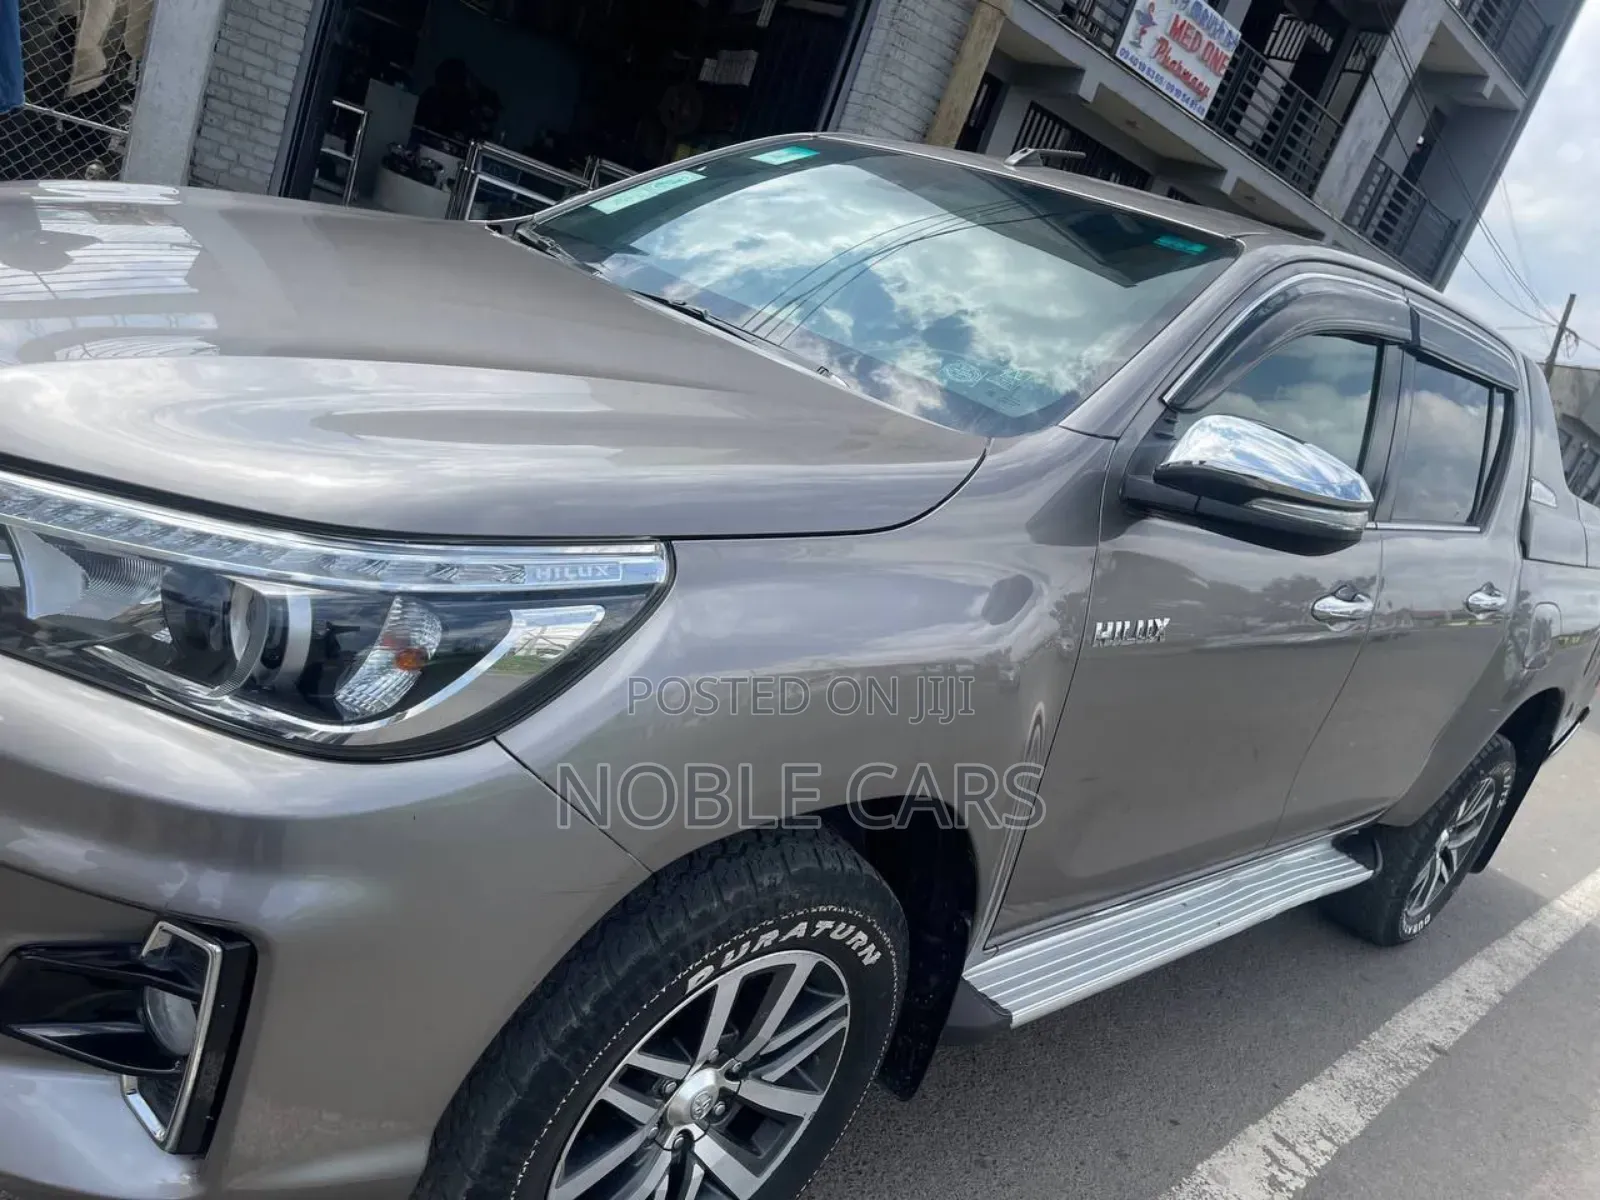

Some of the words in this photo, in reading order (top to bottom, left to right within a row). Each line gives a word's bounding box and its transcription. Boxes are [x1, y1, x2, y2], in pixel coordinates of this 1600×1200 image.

[1169, 13, 1203, 53] MED
[1202, 39, 1230, 77] ONE
[536, 565, 610, 581] HILUX
[1092, 617, 1171, 647] HILUX
[685, 920, 882, 995] DURATURN
